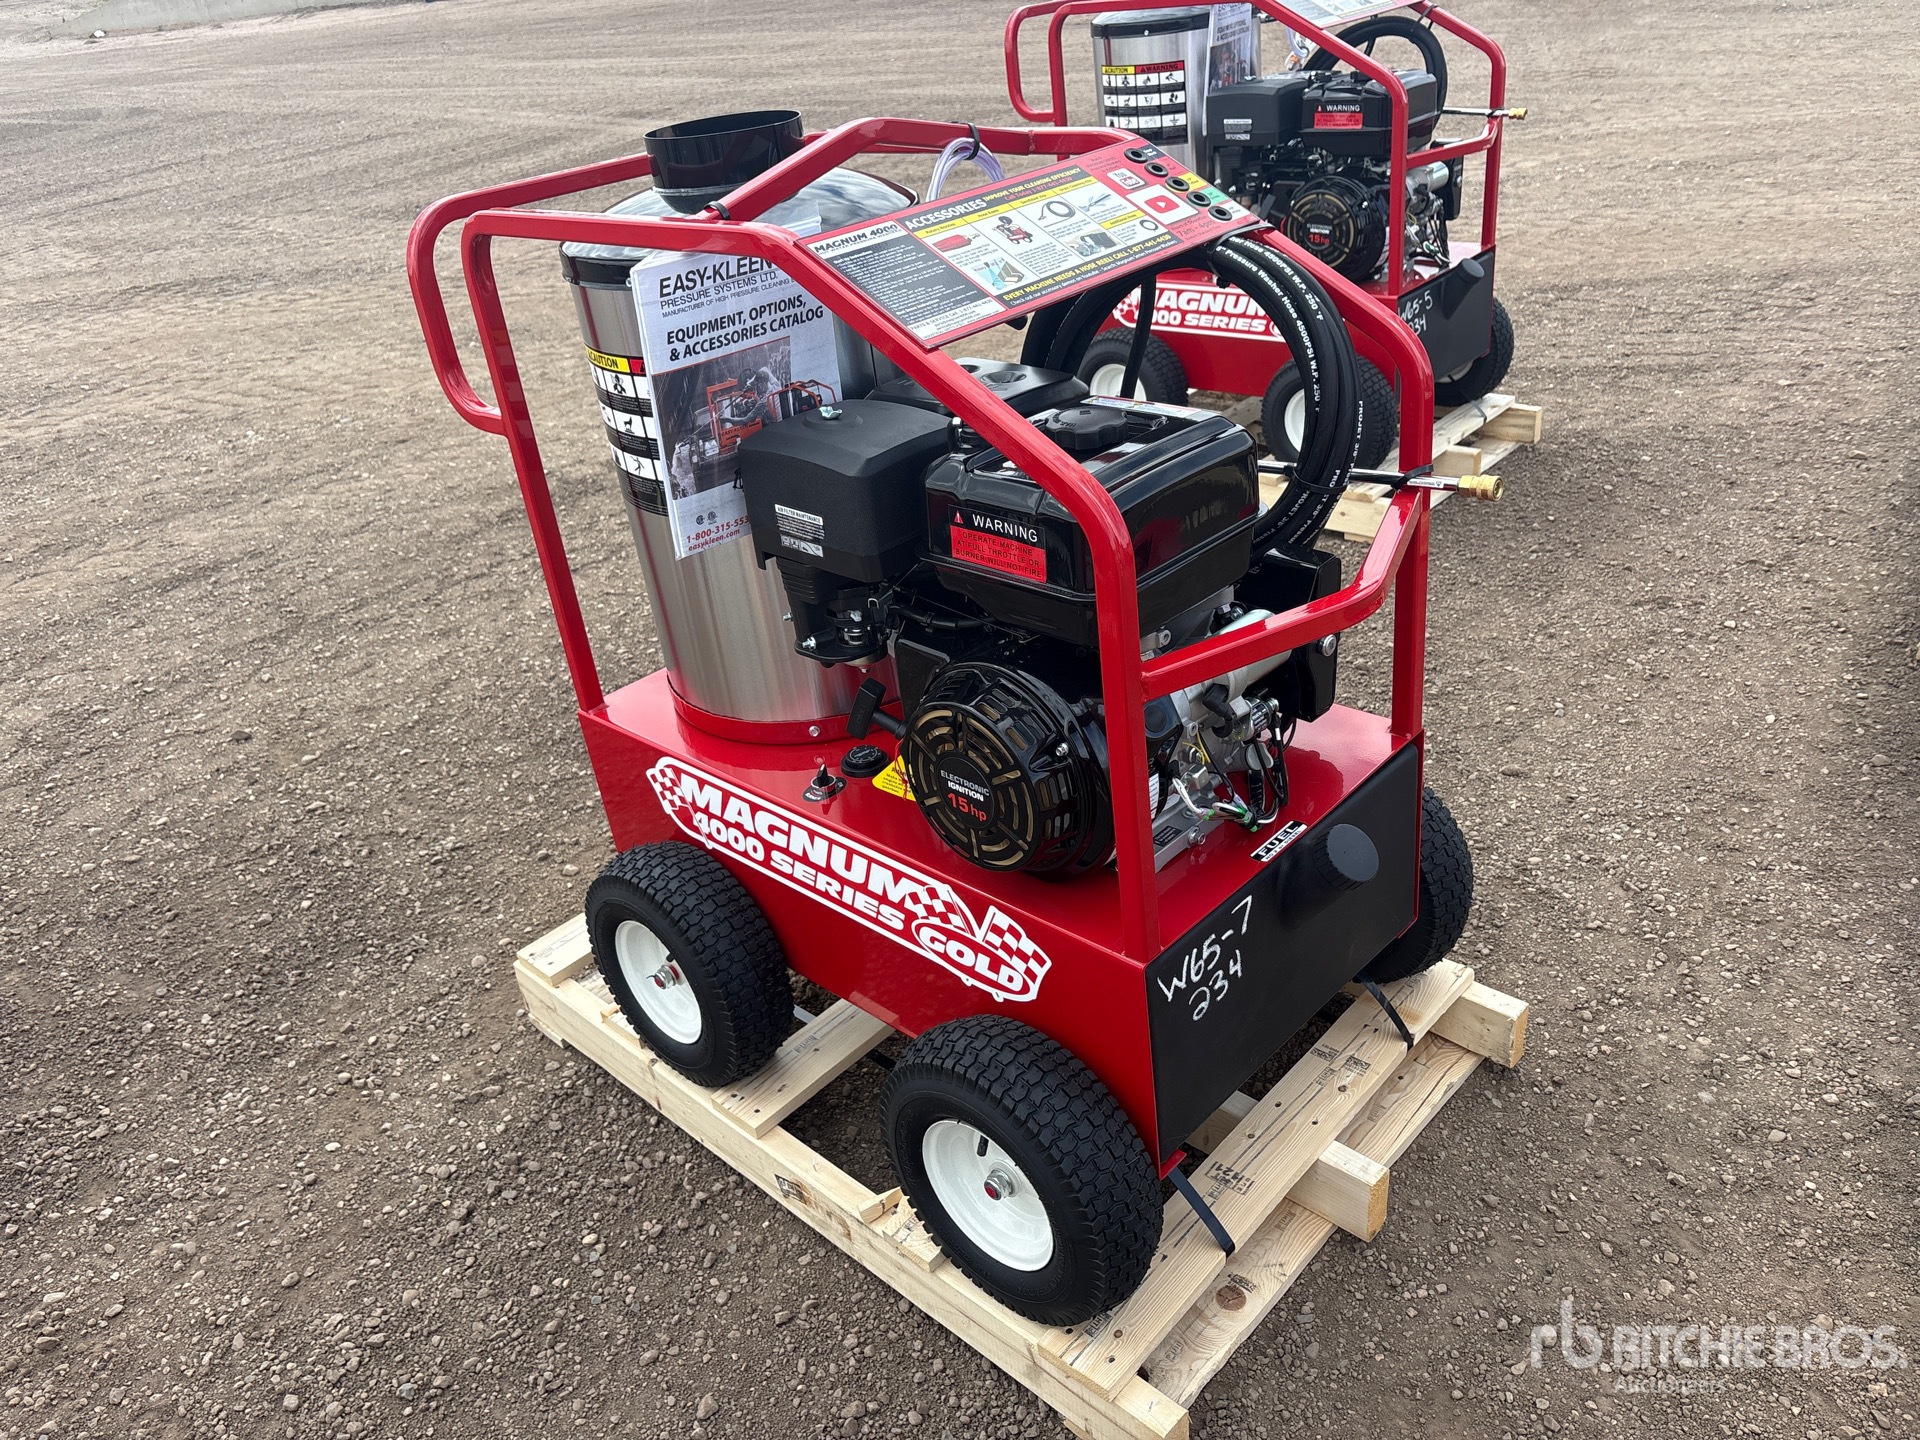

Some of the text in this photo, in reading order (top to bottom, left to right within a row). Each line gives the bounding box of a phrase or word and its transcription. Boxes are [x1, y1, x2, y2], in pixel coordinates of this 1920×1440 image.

[1146, 63, 1178, 72] WARNING
[982, 167, 1081, 201] IMPROVE YOUR CLEANING EFFICIENCY
[1004, 193, 1015, 201] Call
[1015, 188, 1032, 198] Today
[904, 198, 985, 230] ACCESSORIES
[925, 226, 940, 234] Rotary
[1178, 226, 1194, 236] 7am
[1197, 218, 1215, 229] 4pm
[813, 222, 897, 253] MAGNUM 4000
[659, 257, 772, 298] EASY-KLEEN
[660, 288, 712, 310] PRESSURE
[714, 276, 757, 298] SYSTEMS
[759, 270, 779, 284] LTD.
[1003, 288, 1025, 301] EVERY
[1024, 277, 1055, 293] MACHINE
[1054, 270, 1075, 282] NEEDS
[1080, 262, 1097, 272] HOSE
[1112, 249, 1128, 259] CALL
[1243, 239, 1264, 253] Hose
[1264, 250, 1294, 276] 4500PSI
[1292, 274, 1307, 294] W.P.
[1305, 293, 1319, 310] 250
[662, 302, 705, 319] MANUFACTURER
[706, 299, 714, 307] OF
[715, 296, 730, 306] HIGH
[730, 287, 761, 300] PRESSURE
[761, 280, 790, 293] CLEANING
[1009, 297, 1025, 306] Check
[1225, 250, 1258, 272] Pressure
[1258, 269, 1284, 297] Washer
[1282, 296, 1298, 319] Hose
[1296, 319, 1315, 359] 4500PSI
[667, 294, 807, 345] EQUIPMENT, OPTIONS,
[669, 305, 824, 362] & ACCESSORIES CATALOG
[1183, 311, 1267, 333] SERIES
[1356, 400, 1364, 439] PROJET
[784, 508, 796, 517] FILTER
[973, 514, 1038, 543] WARNING
[687, 515, 750, 544] 1-800-315-553
[689, 529, 741, 552] easykleen.com
[962, 531, 1033, 557] OPERATE MACHINE
[955, 548, 1042, 578] BURNER WILL NOT FIRE
[957, 539, 1040, 567] AT FULL THROTTLE OR
[940, 769, 990, 797] ELECTRONIC
[947, 781, 984, 802] IGNITION
[680, 772, 913, 904] MAGNUM
[1257, 823, 1299, 856] FUEL
[692, 813, 905, 932] 4000 SERIES
[920, 929, 1025, 994] GOLD
[1157, 895, 1253, 1002] W65-7
[1188, 949, 1242, 1021] 234
